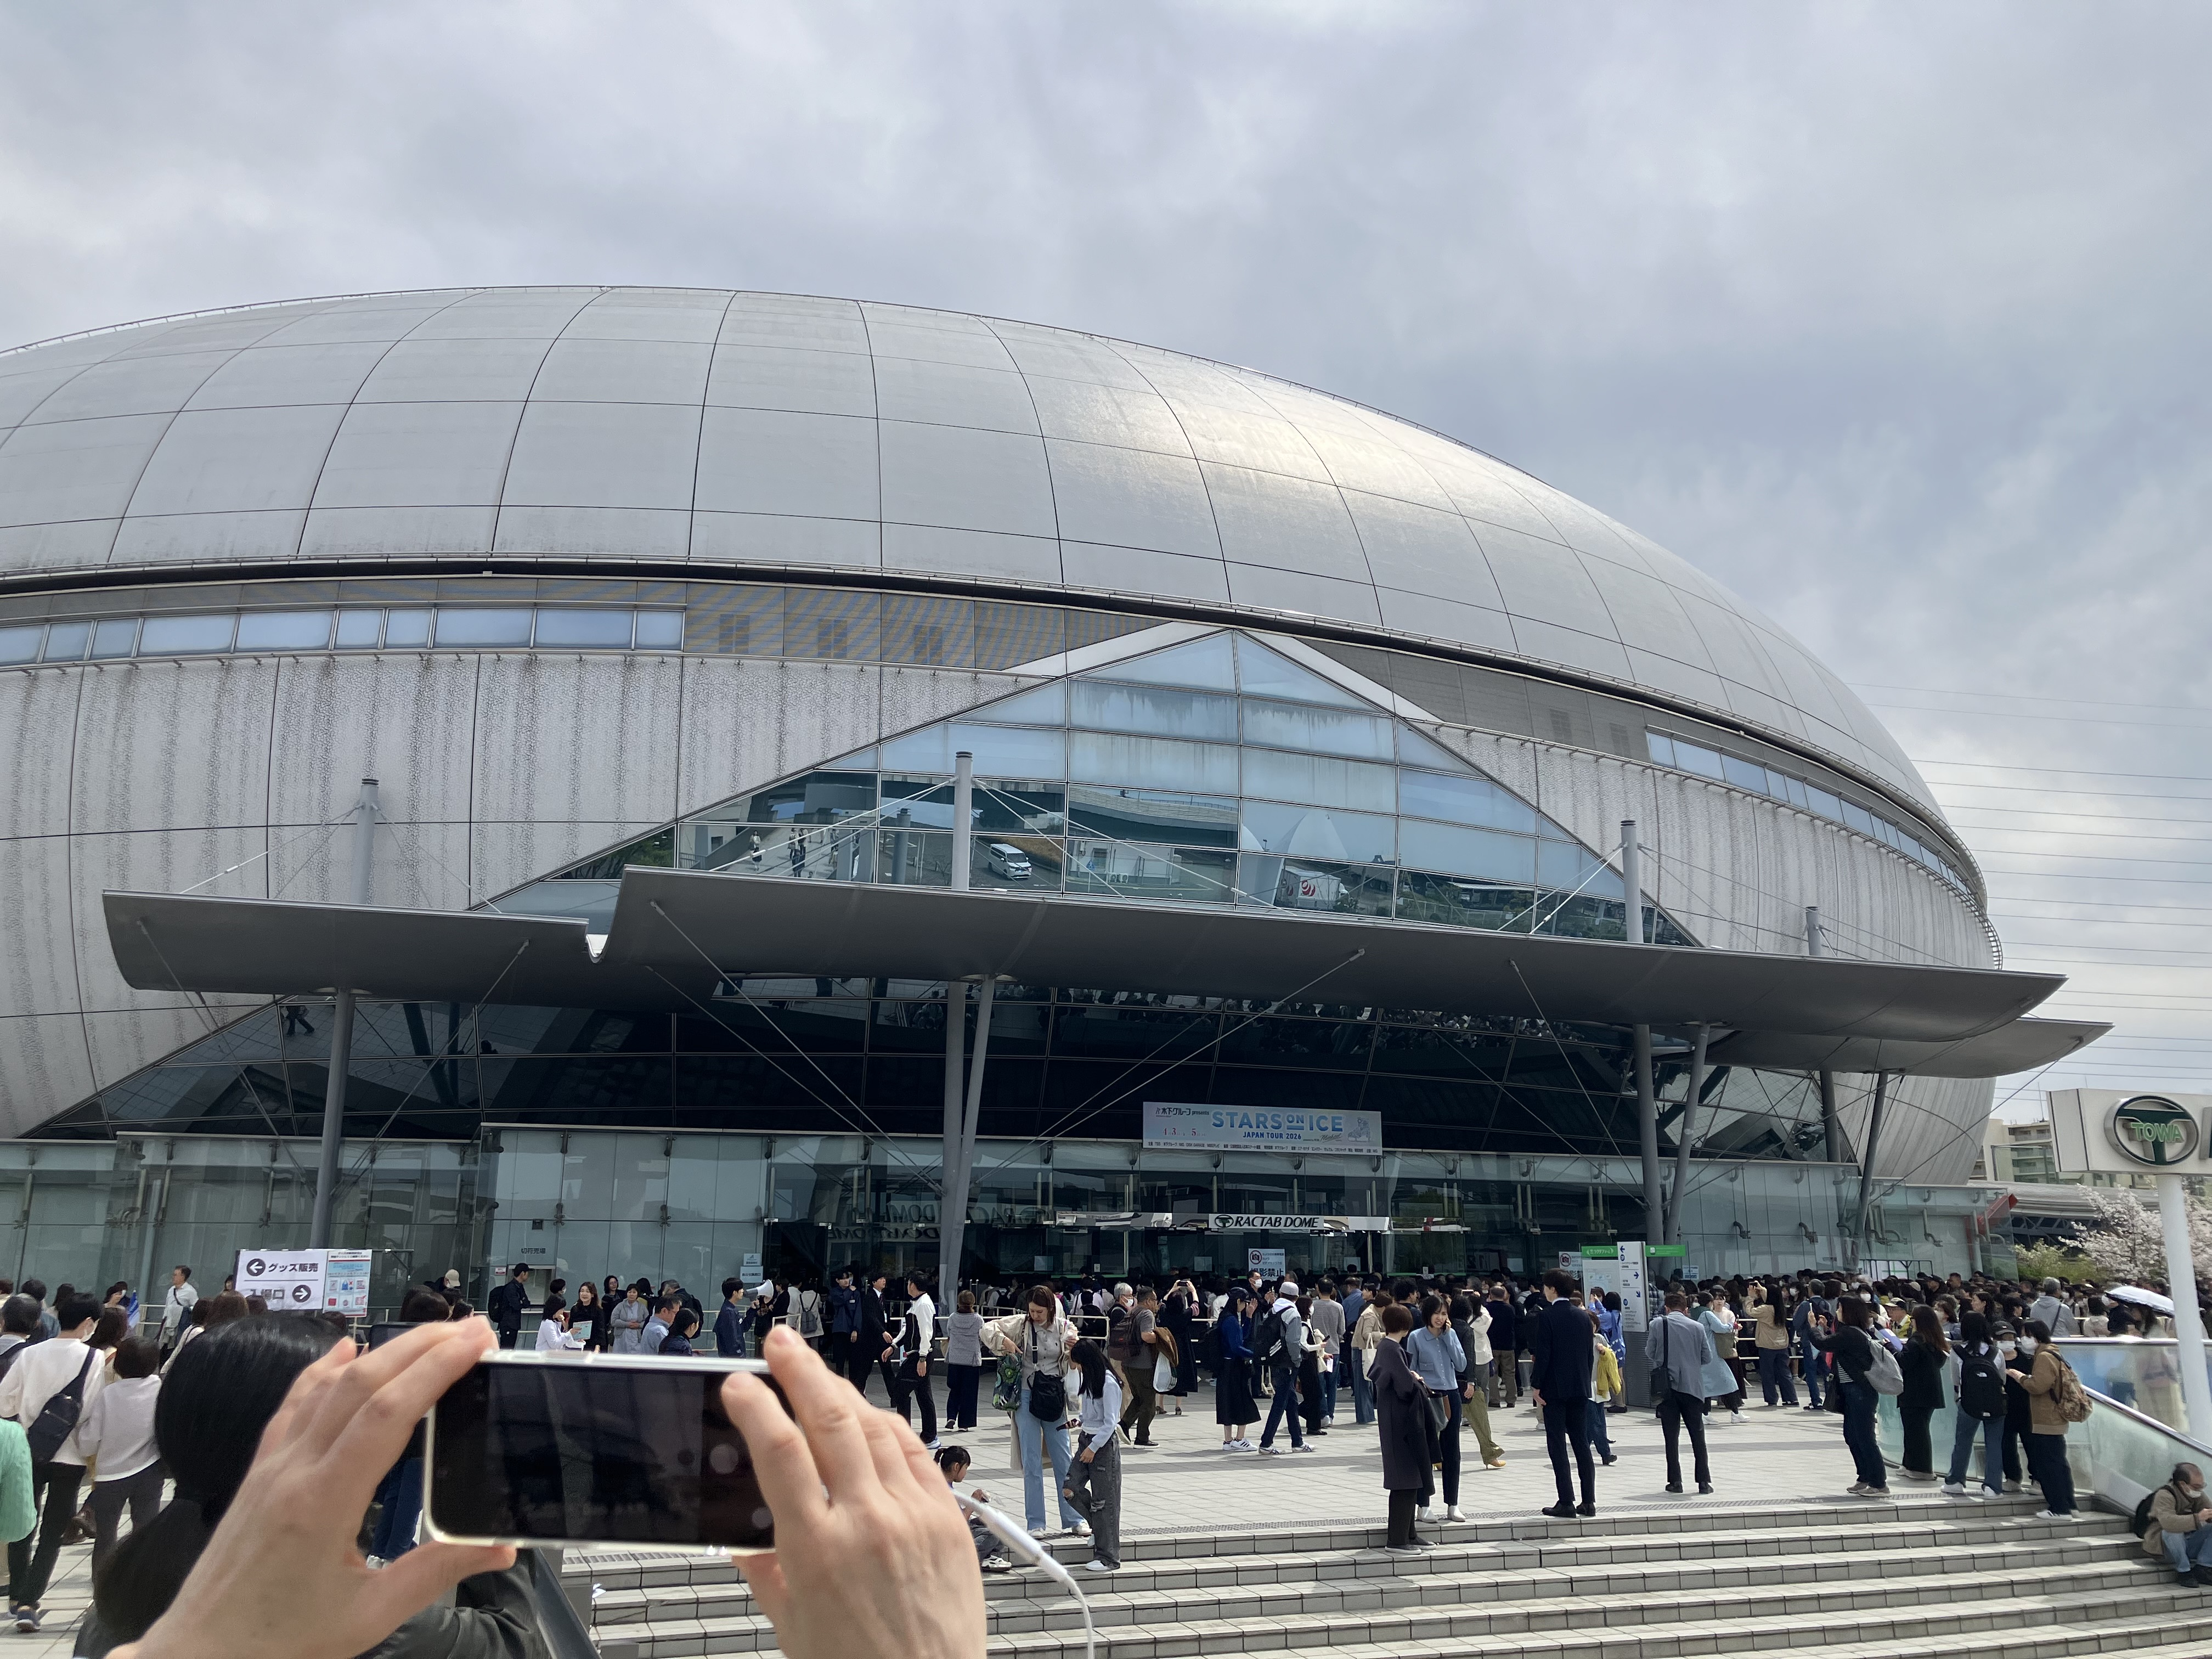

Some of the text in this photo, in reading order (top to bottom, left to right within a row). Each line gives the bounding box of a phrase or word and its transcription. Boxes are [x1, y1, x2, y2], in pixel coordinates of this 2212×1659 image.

[1161, 1107, 1192, 1115] 木下グループ
[1211, 1110, 1343, 1132] STARS ON ICE
[2130, 1122, 2185, 1143] TOWA
[1234, 1216, 1319, 1228] RACTAB DOME
[268, 1263, 319, 1272] グッズ販売
